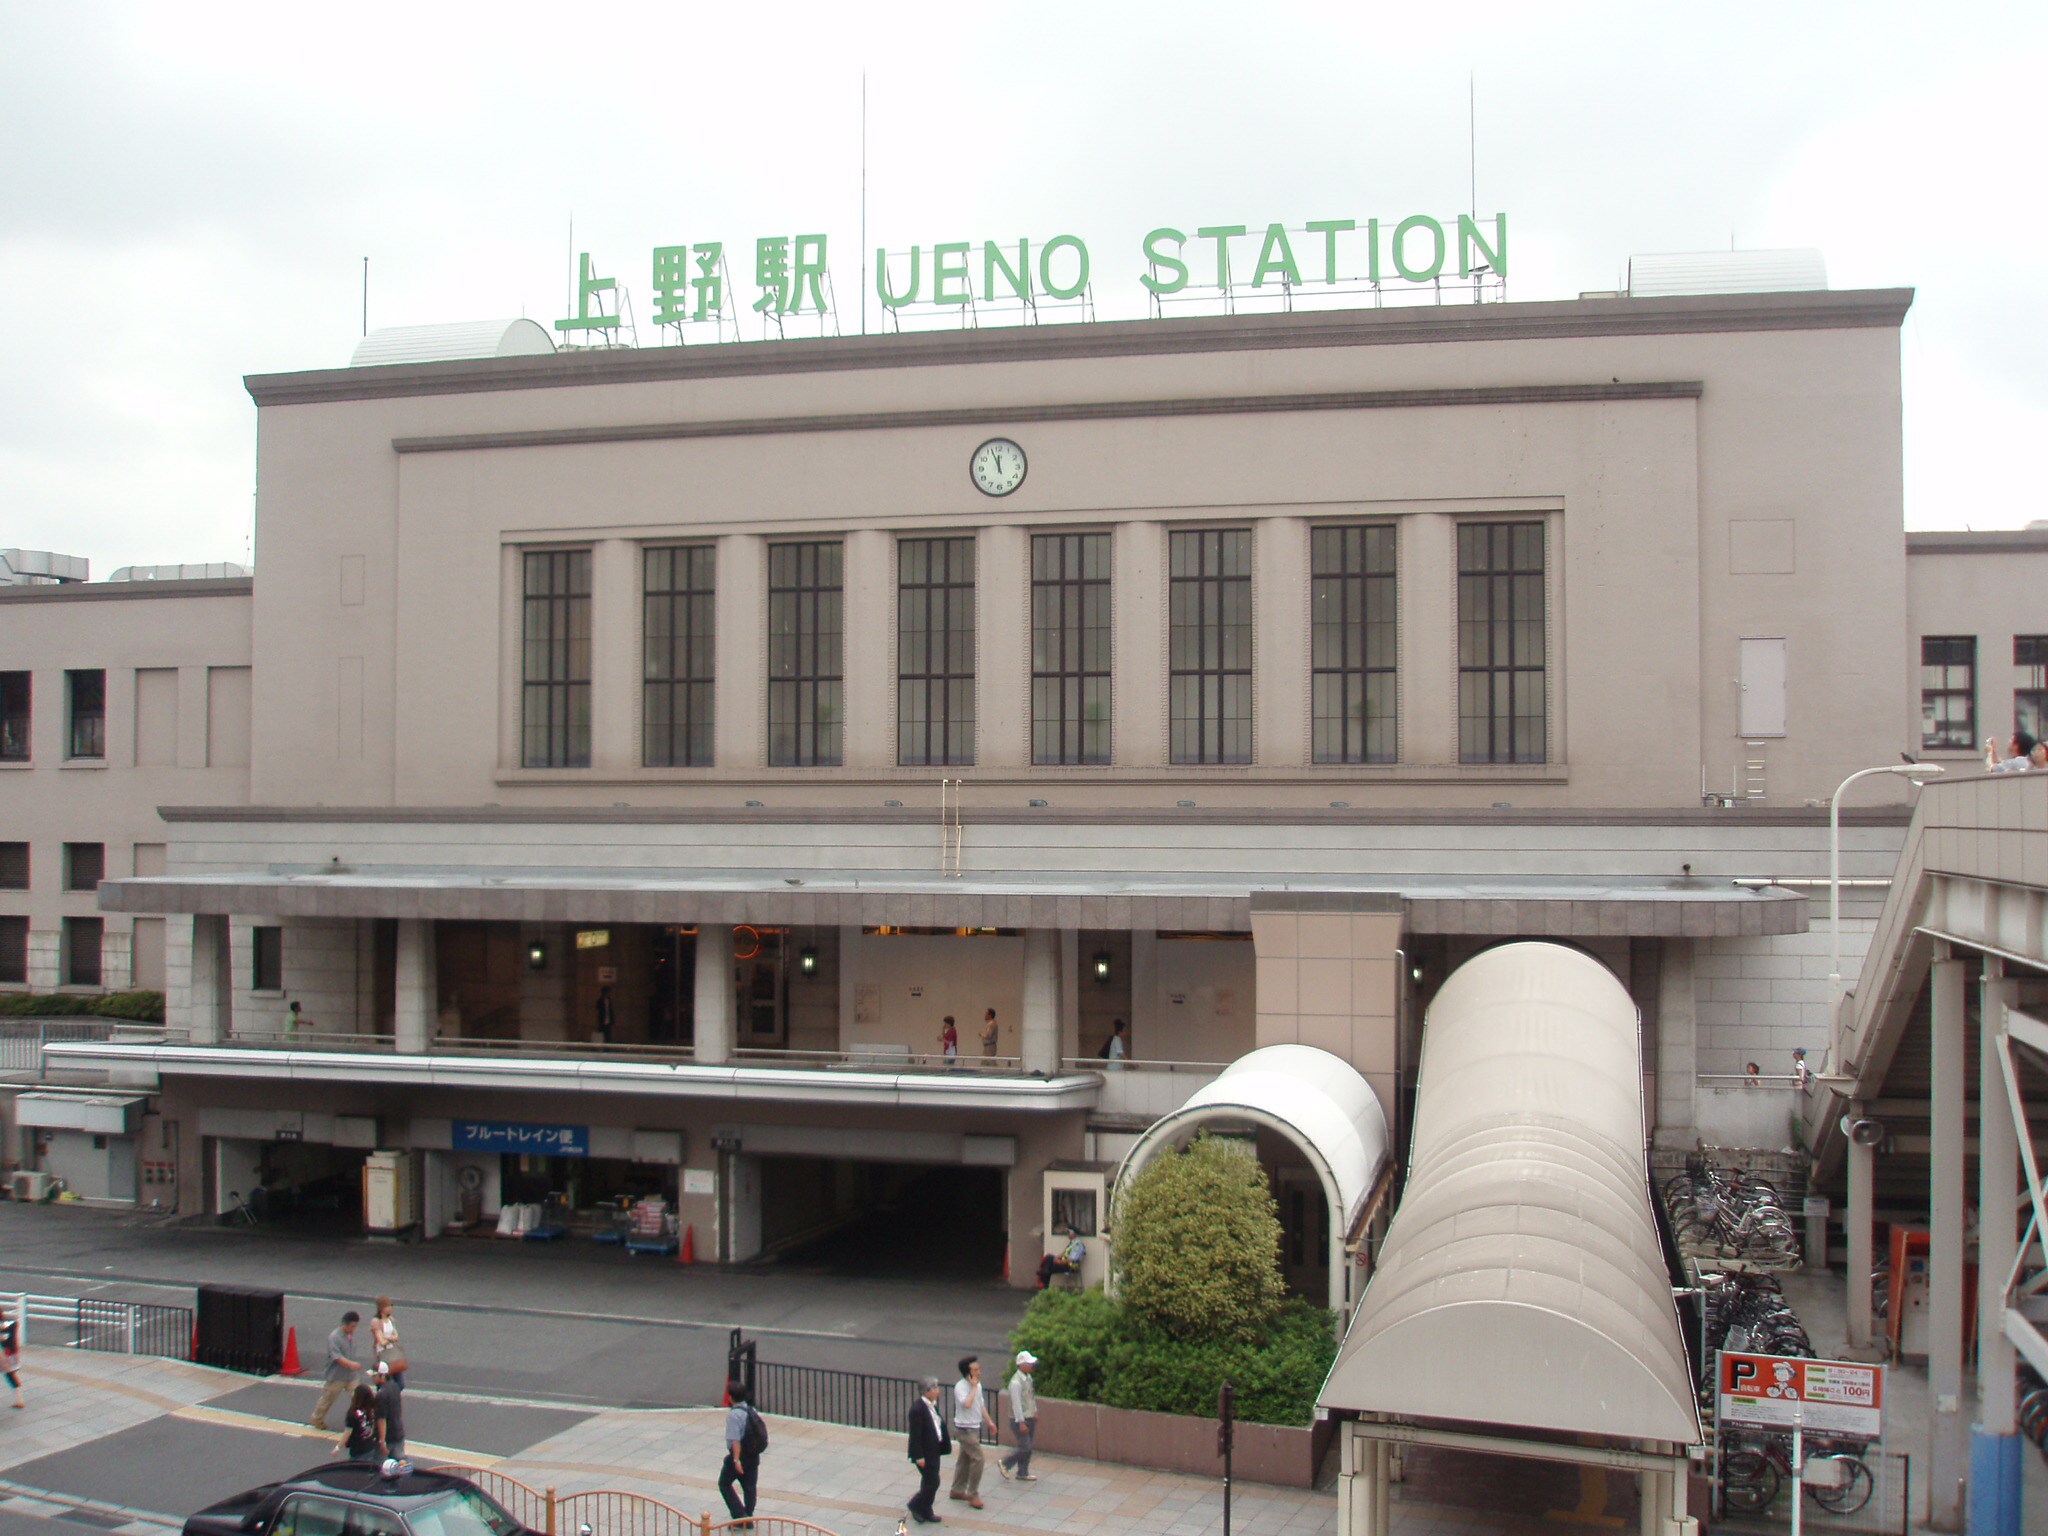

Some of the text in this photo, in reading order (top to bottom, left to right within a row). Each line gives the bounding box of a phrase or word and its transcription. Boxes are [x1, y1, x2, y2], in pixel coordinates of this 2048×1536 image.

[553, 212, 1508, 331] 上野駅 UENO STATION
[465, 1125, 574, 1145] ブルートレイン便
[1731, 1359, 1757, 1391] P
[1843, 1386, 1870, 1396] 100円
